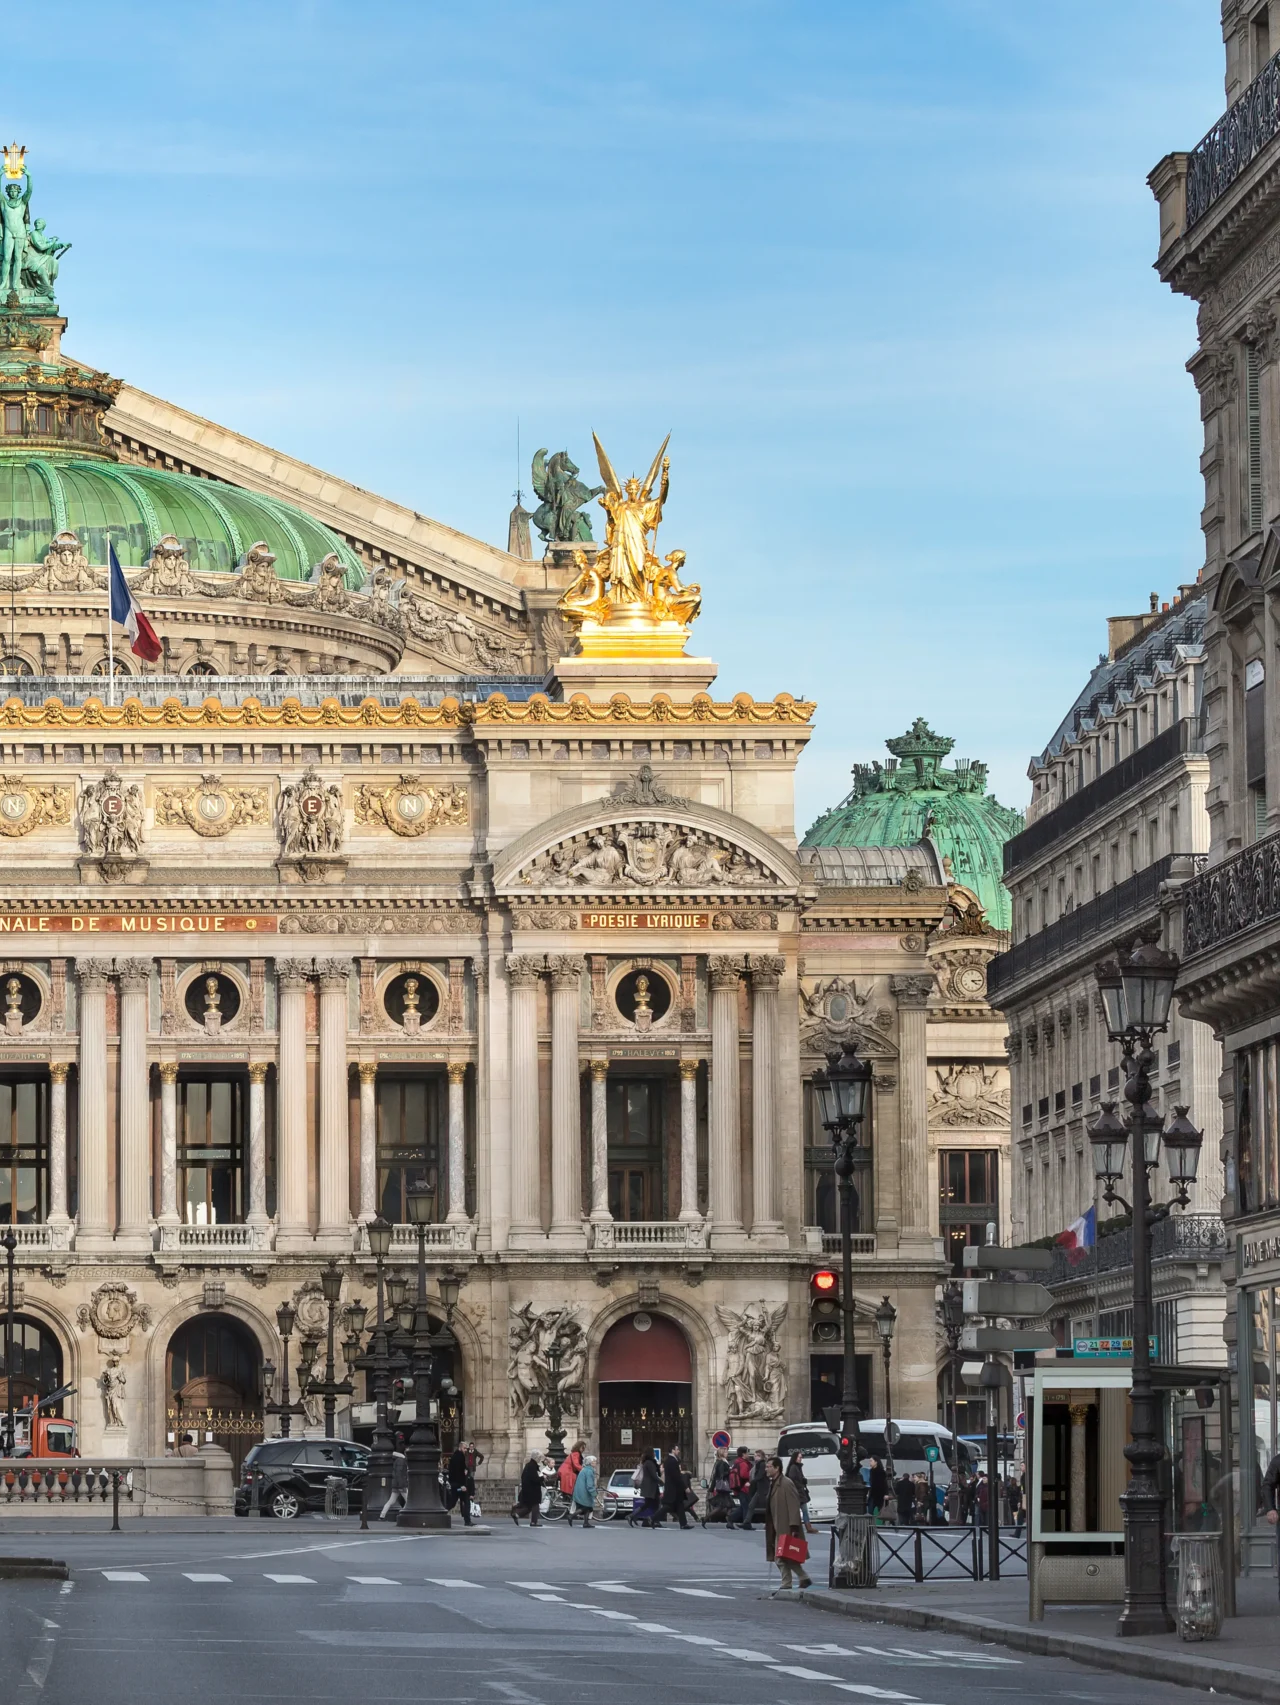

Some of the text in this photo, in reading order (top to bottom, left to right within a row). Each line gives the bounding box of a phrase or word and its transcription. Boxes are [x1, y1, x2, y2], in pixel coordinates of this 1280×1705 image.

[8, 800, 19, 812] N
[108, 800, 118, 812] E
[206, 800, 218, 812] N
[308, 800, 317, 812] E
[404, 799, 416, 812] N
[71, 917, 100, 932] DE
[122, 917, 225, 932] MUSIQUE
[590, 914, 700, 928] POESIE LYRIQUE
[776, 1644, 1024, 1664] BUS
